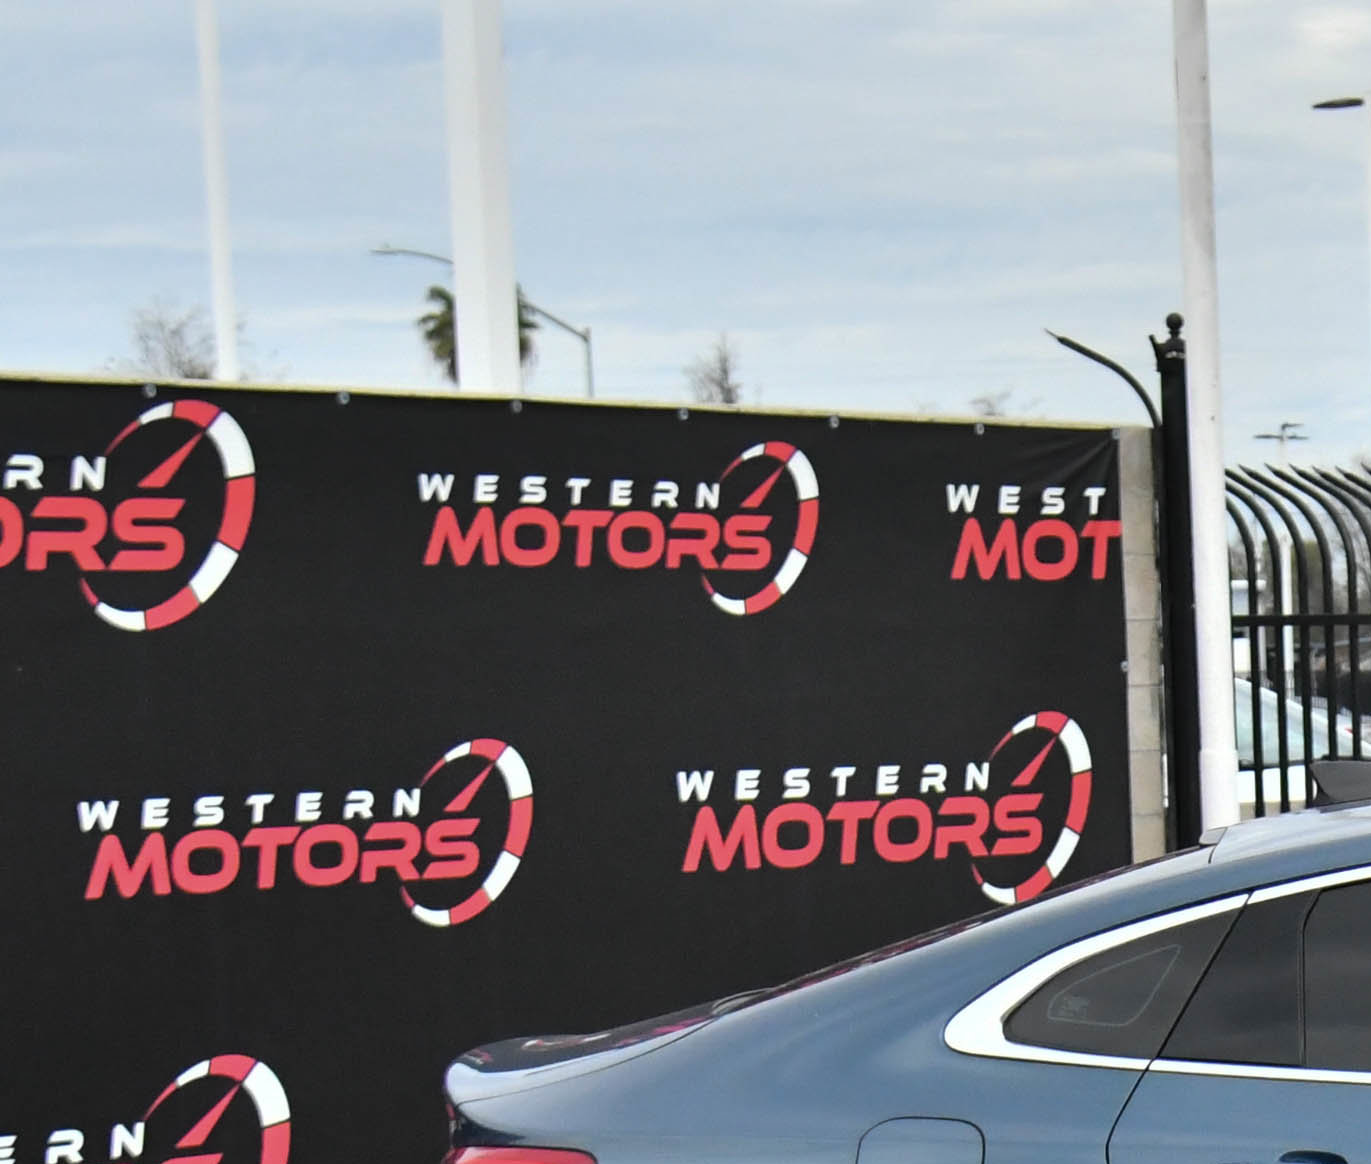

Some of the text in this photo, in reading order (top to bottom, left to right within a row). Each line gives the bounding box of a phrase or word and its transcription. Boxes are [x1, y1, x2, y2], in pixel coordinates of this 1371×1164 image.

[418, 473, 720, 509] WESTERN
[946, 483, 1106, 515] WEST
[0, 496, 185, 572] RS
[423, 506, 772, 571] MOTORS
[951, 517, 1123, 581] MOT
[77, 788, 421, 832] WESTERN
[677, 761, 990, 803] WESTERN
[85, 817, 481, 900] MOTORS
[682, 793, 1044, 873] MOTORS
